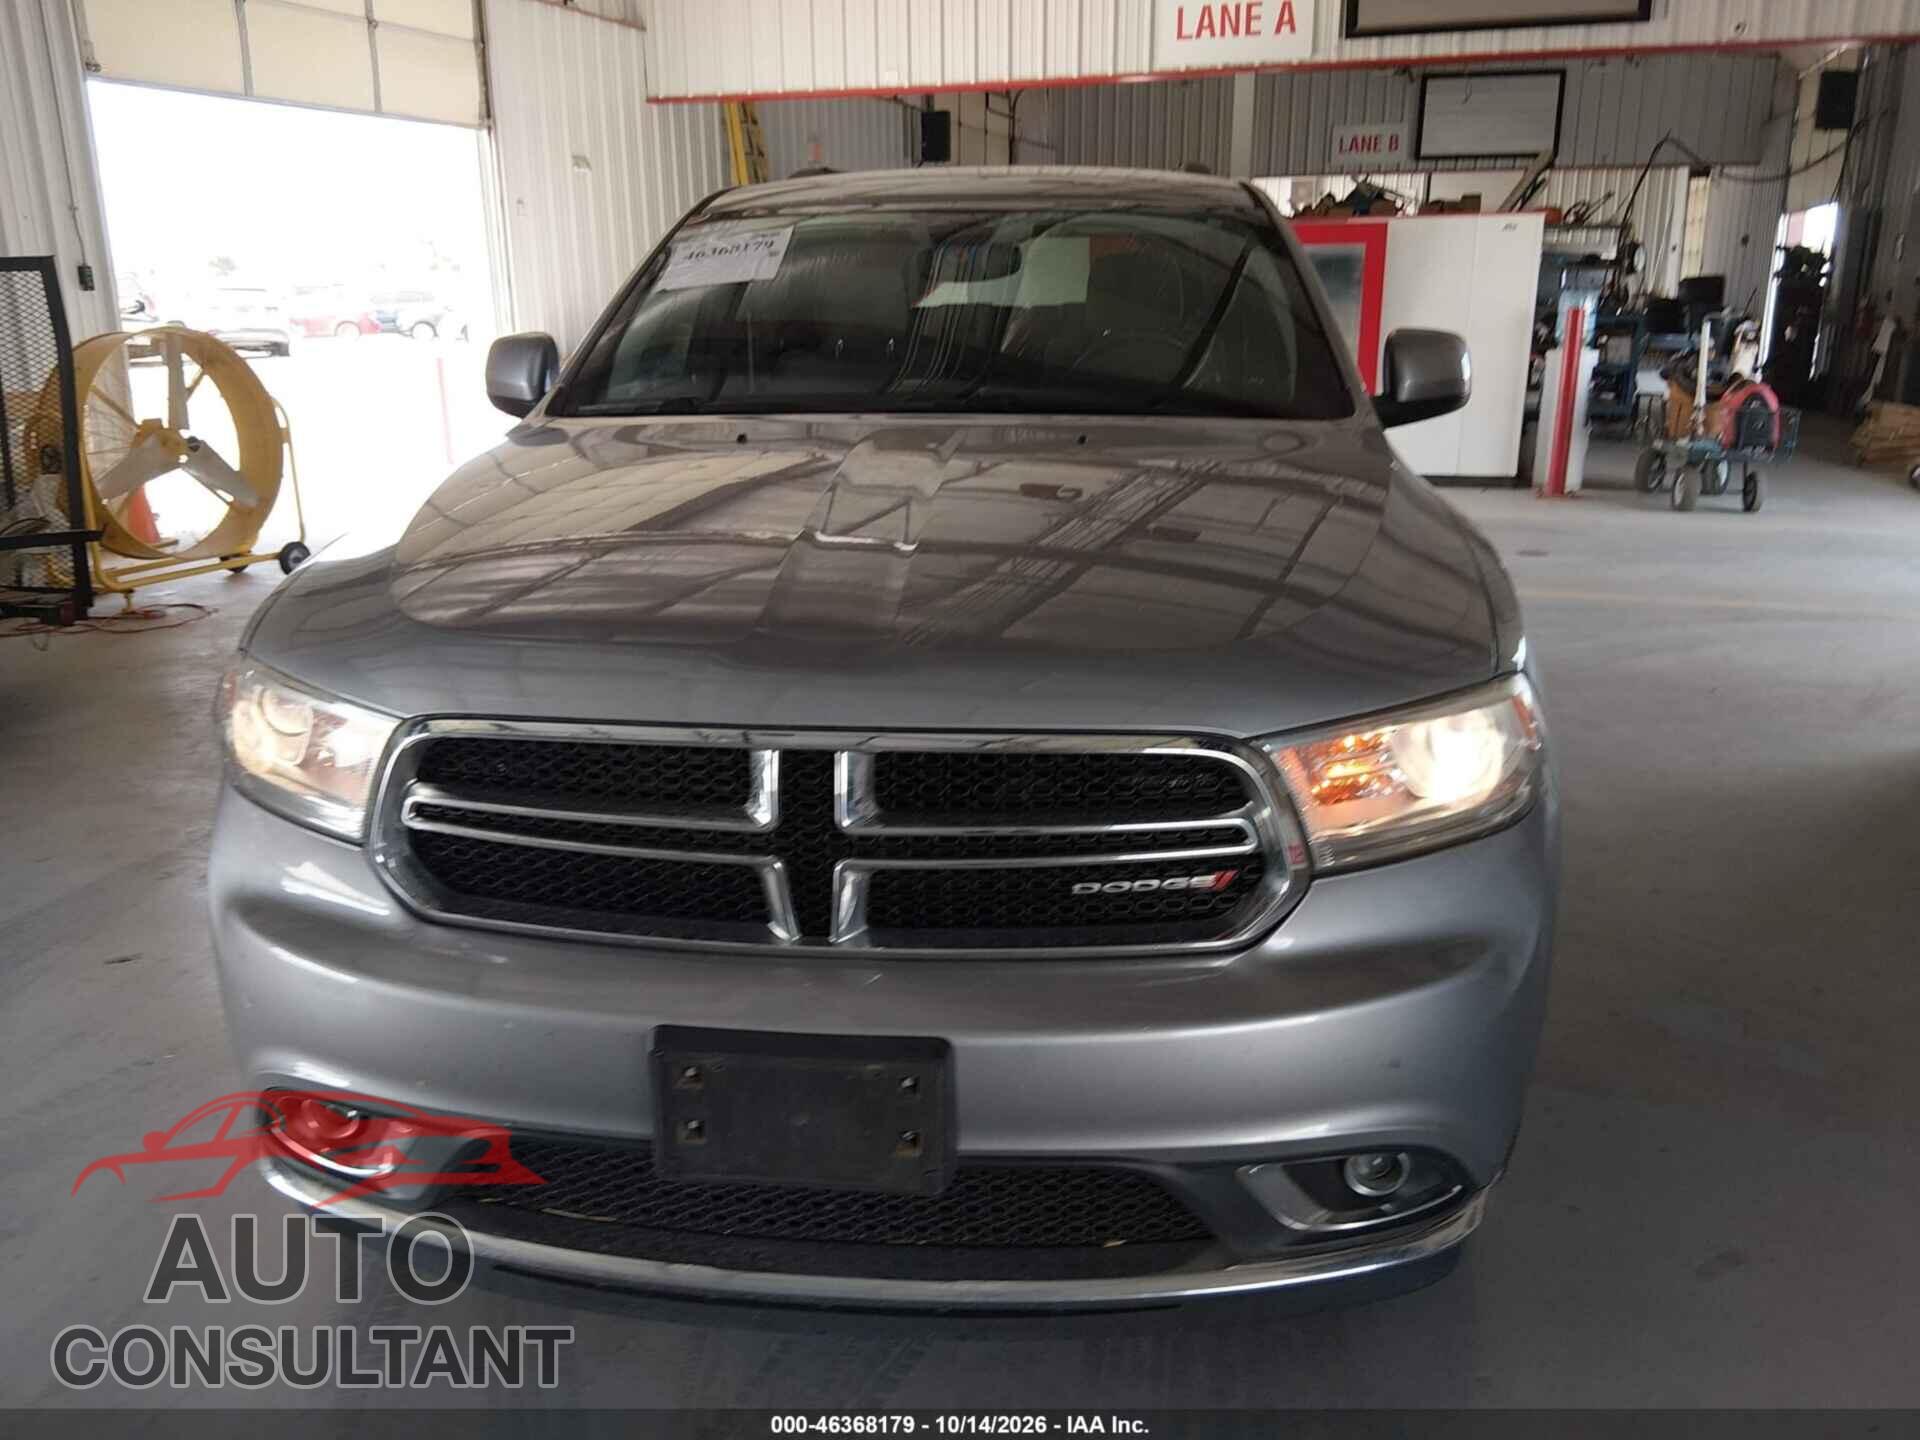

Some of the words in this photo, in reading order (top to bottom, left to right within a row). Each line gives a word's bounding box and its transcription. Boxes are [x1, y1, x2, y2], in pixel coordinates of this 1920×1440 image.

[1176, 2, 1263, 40] LANE
[1274, 0, 1296, 35] A
[1338, 134, 1383, 153] LANE
[1388, 133, 1399, 152] B
[1072, 875, 1217, 895] DODGE
